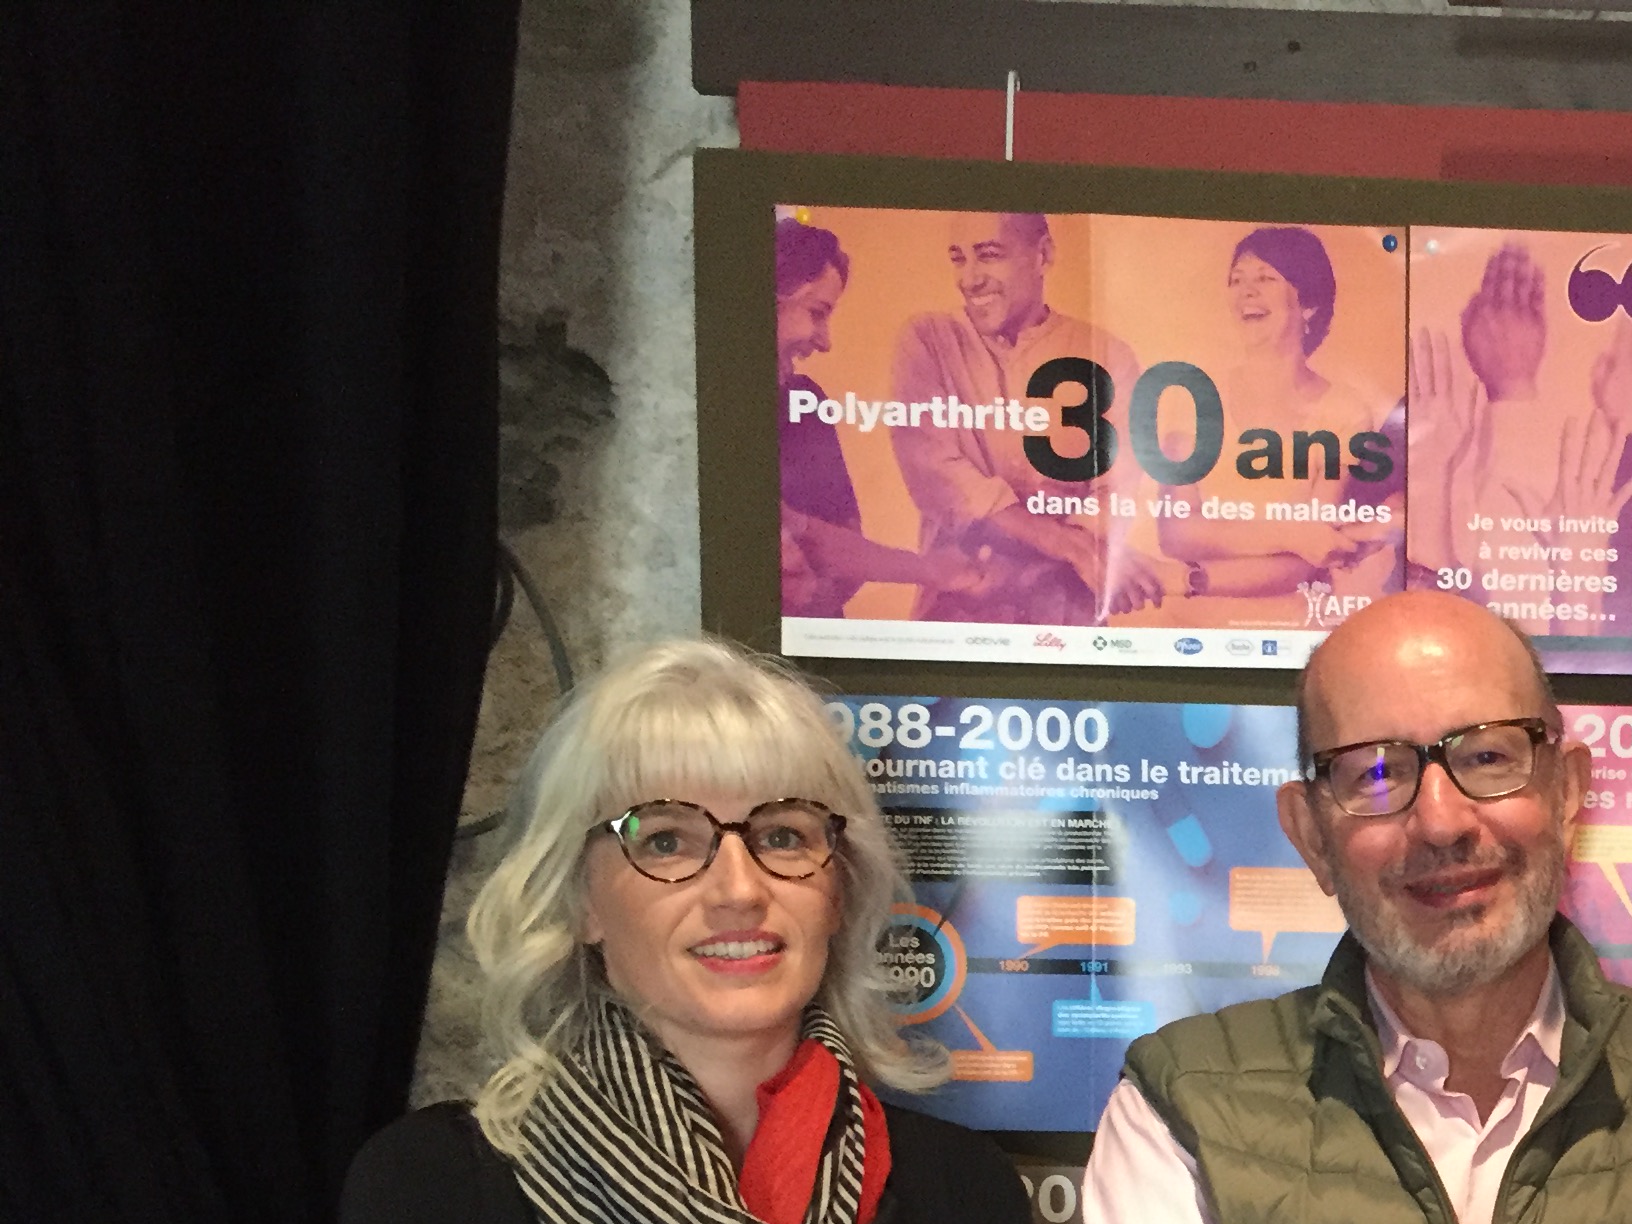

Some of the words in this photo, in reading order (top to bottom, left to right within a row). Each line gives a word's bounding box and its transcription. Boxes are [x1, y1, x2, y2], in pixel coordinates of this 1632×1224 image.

[788, 390, 1050, 433] Polyarthrite
[1023, 357, 1224, 486] 30
[1235, 427, 1395, 482] ans
[1026, 490, 1100, 516] dans
[1110, 493, 1136, 518] la
[1147, 493, 1191, 519] vie
[1202, 496, 1254, 521] des
[1265, 497, 1392, 524] malades
[1467, 514, 1494, 533] Je
[1499, 517, 1551, 534] vous
[1558, 514, 1619, 534] invite
[1478, 542, 1492, 561] à
[1499, 544, 1573, 562] revivre
[1579, 546, 1619, 562] ces
[1436, 567, 1473, 591] 30
[1481, 568, 1618, 593] dernières
[822, 701, 1109, 752] 988-2000
[999, 755, 1046, 781] clé
[1056, 757, 1130, 783] dans
[1141, 759, 1168, 783] le
[944, 781, 1063, 798] inflammatoires
[1070, 785, 1159, 802] chroniques
[1583, 790, 1615, 810] es
[1079, 961, 1109, 973] 1991
